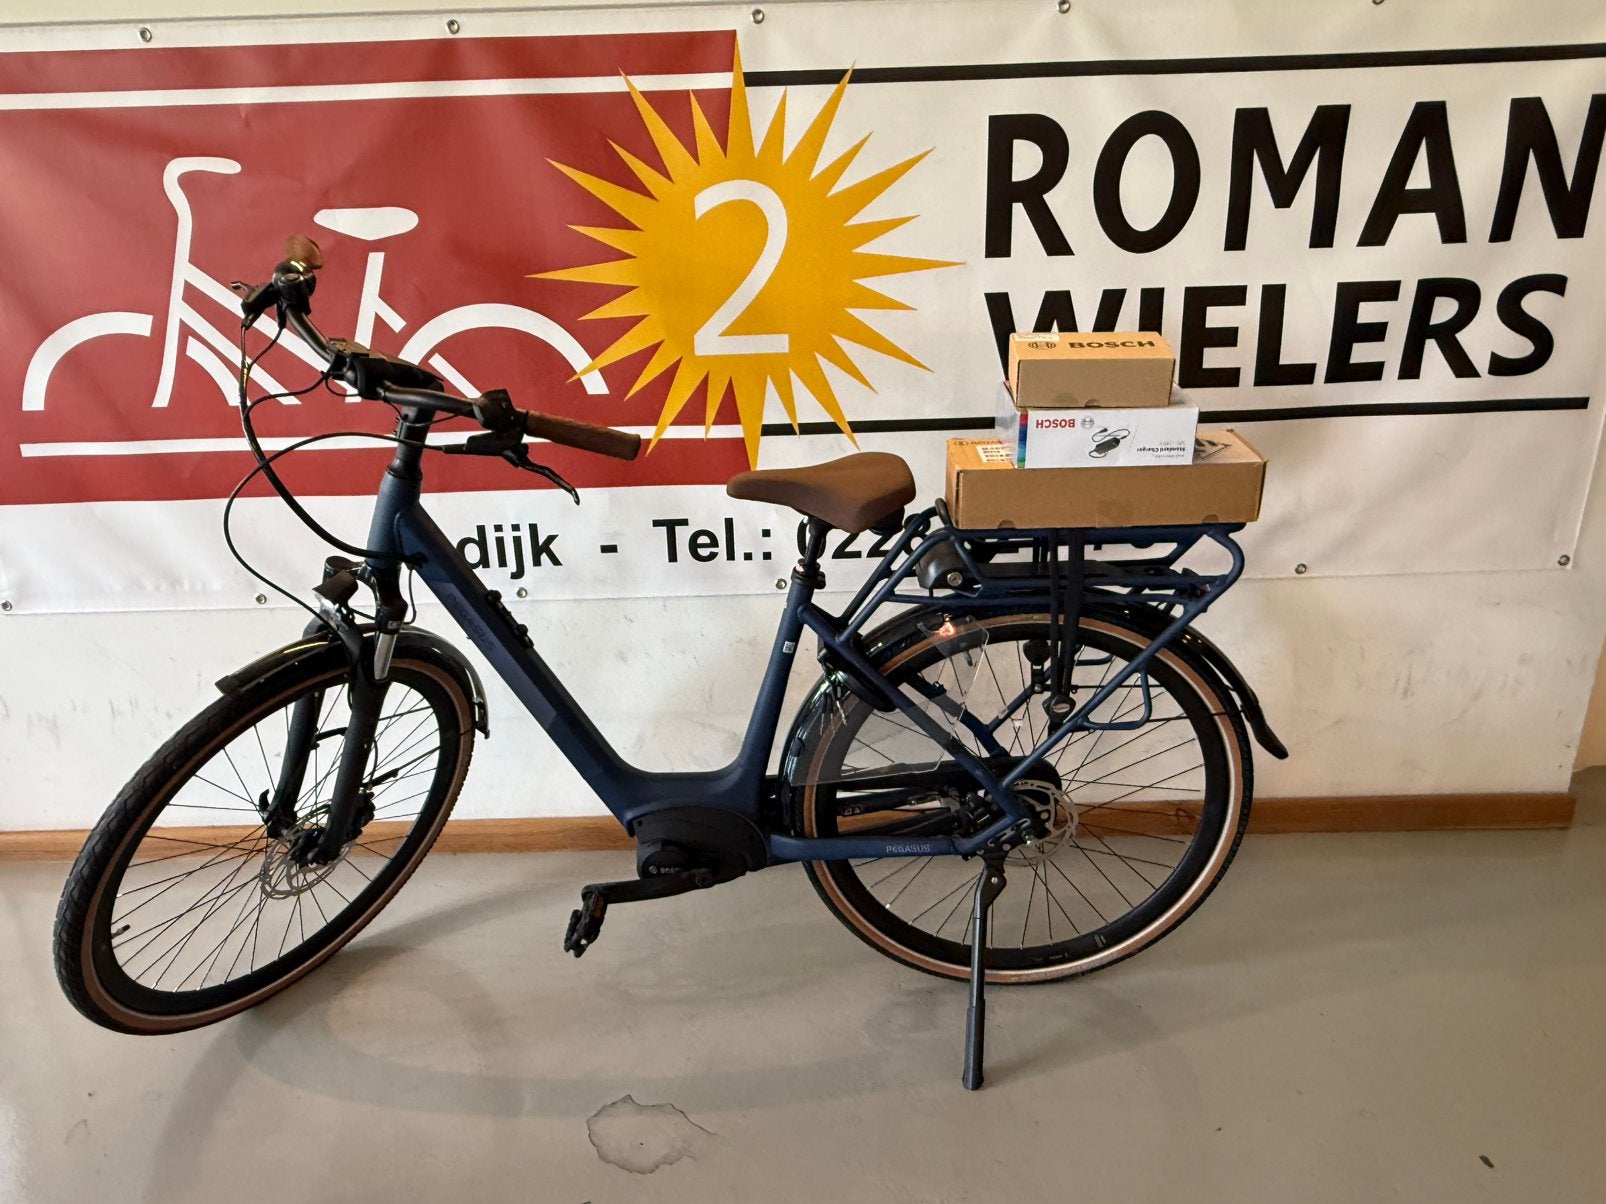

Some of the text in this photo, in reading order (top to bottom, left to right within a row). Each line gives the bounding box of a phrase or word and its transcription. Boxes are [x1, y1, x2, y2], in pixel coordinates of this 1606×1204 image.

[985, 93, 1606, 258] ROMAN
[694, 179, 789, 356] 2
[1069, 340, 1155, 349] BOSCH
[1035, 418, 1076, 429] BOSCH
[652, 517, 773, 564] Tel.:
[885, 843, 931, 853] PEGASUS
